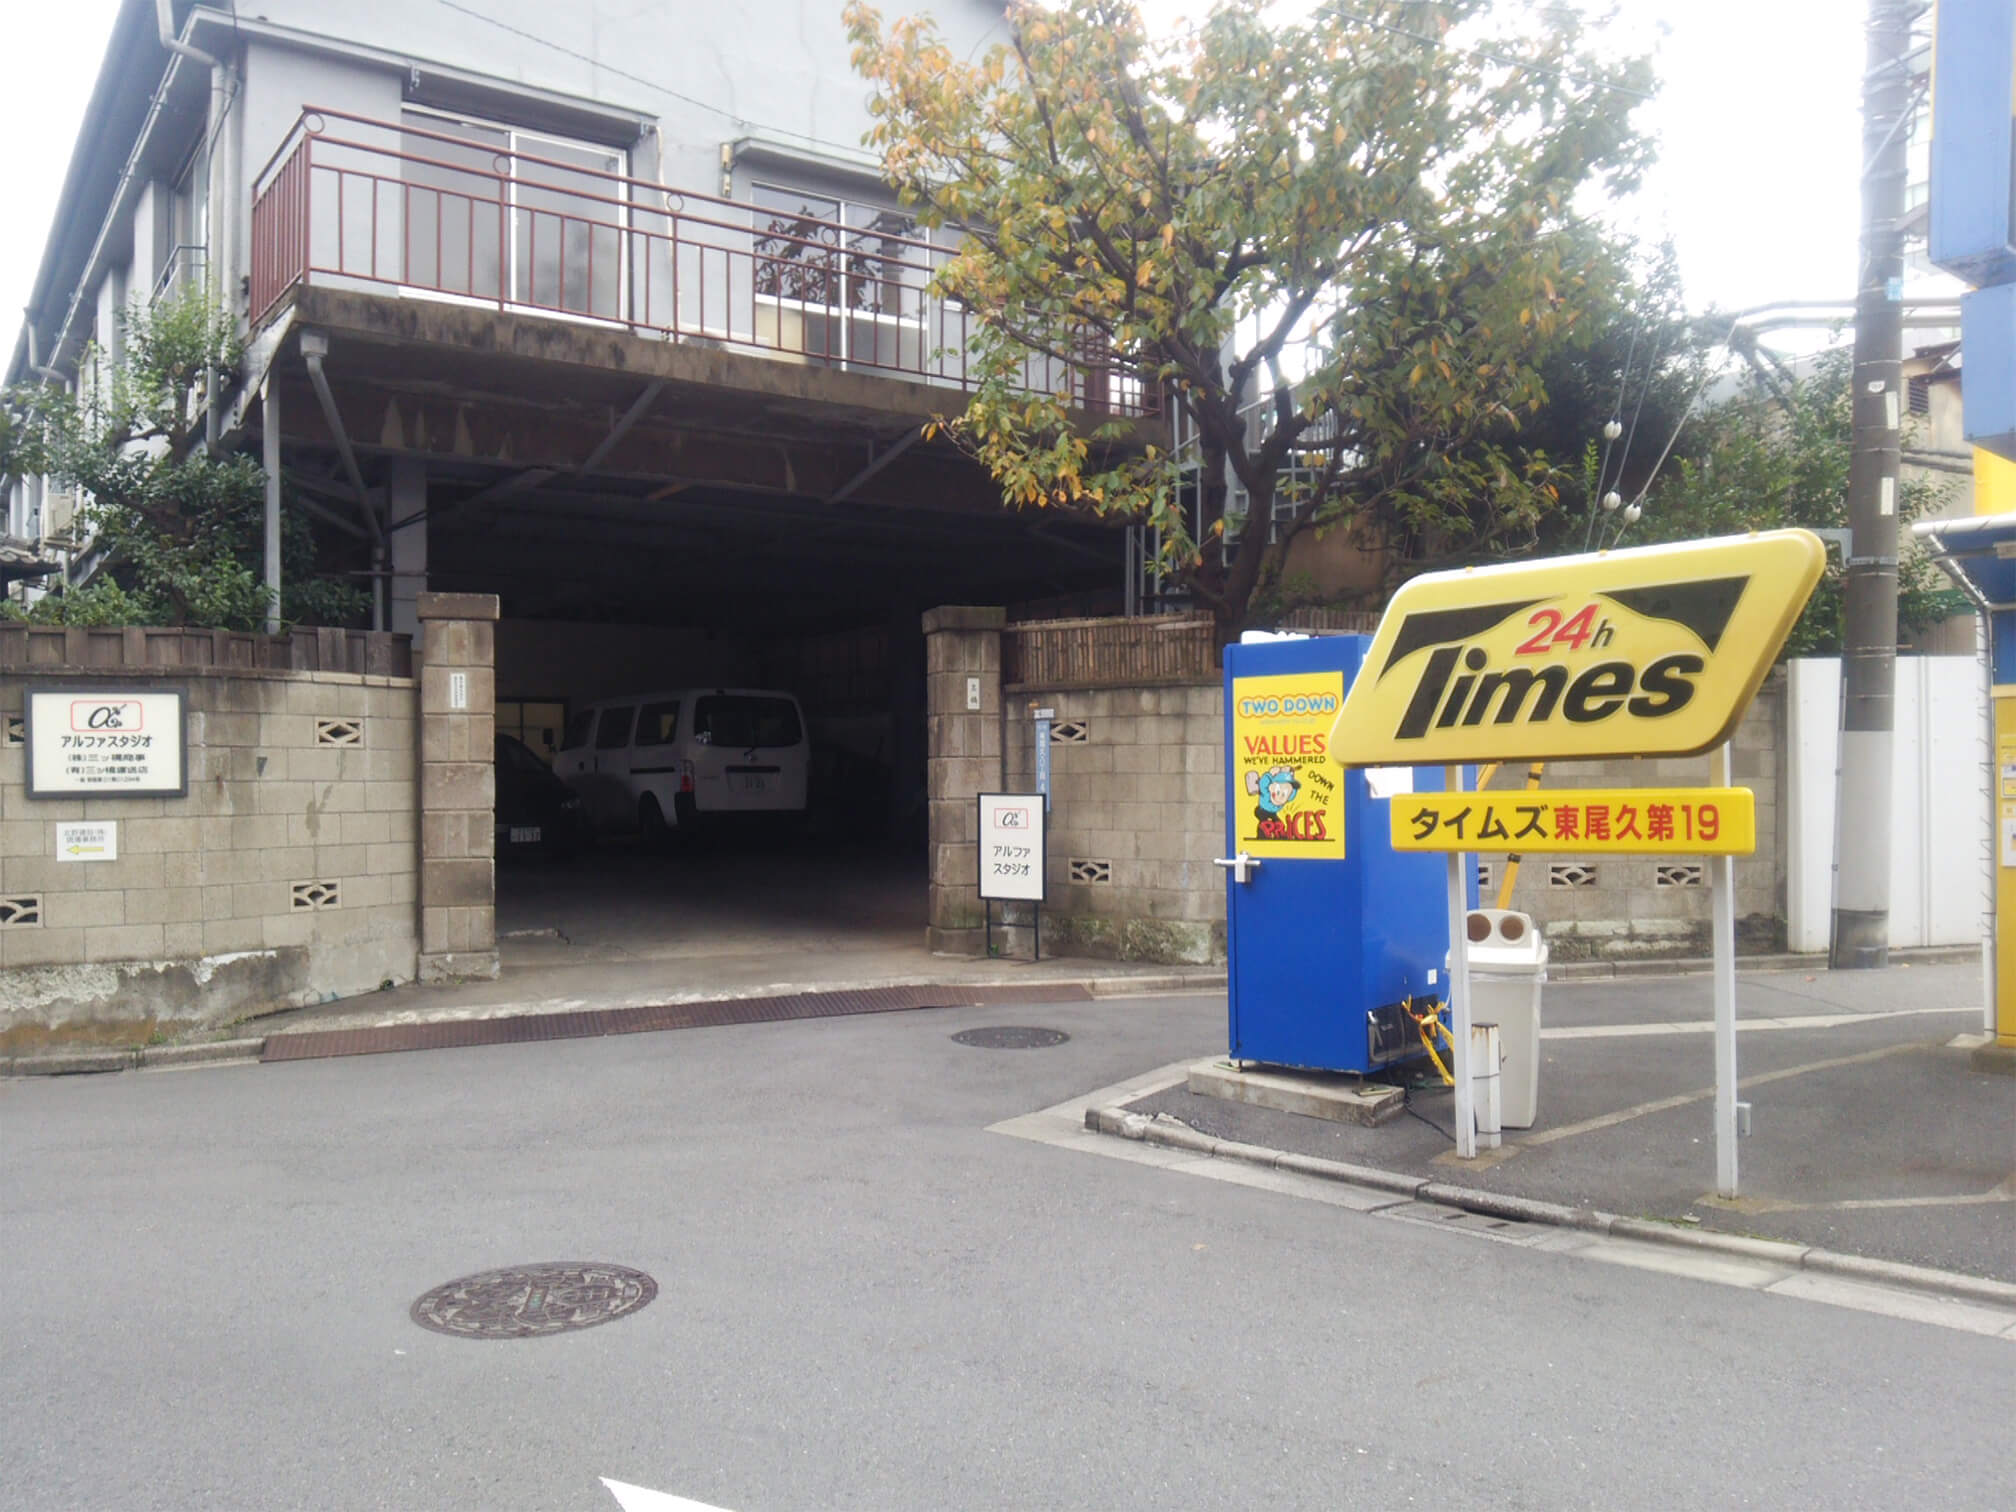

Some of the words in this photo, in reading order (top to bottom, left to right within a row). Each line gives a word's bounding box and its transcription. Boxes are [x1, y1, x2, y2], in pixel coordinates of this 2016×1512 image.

[1514, 602, 1613, 656] 24h
[1394, 646, 1705, 740] Times
[1242, 699, 1278, 714] TWO
[1284, 696, 1336, 713] DOWN
[60, 735, 153, 749] アルファスタジオ
[1243, 734, 1326, 755] VALUES
[1243, 756, 1270, 765] WE'VE
[1272, 756, 1326, 765] HAMMERED
[1308, 770, 1335, 792] DOWN
[1310, 789, 1330, 805] THE
[1259, 809, 1327, 840] PRICES
[1410, 803, 1720, 842] タイムズ東尾久第19
[992, 845, 1031, 858] アルファ
[992, 863, 1031, 877] スタジオ
